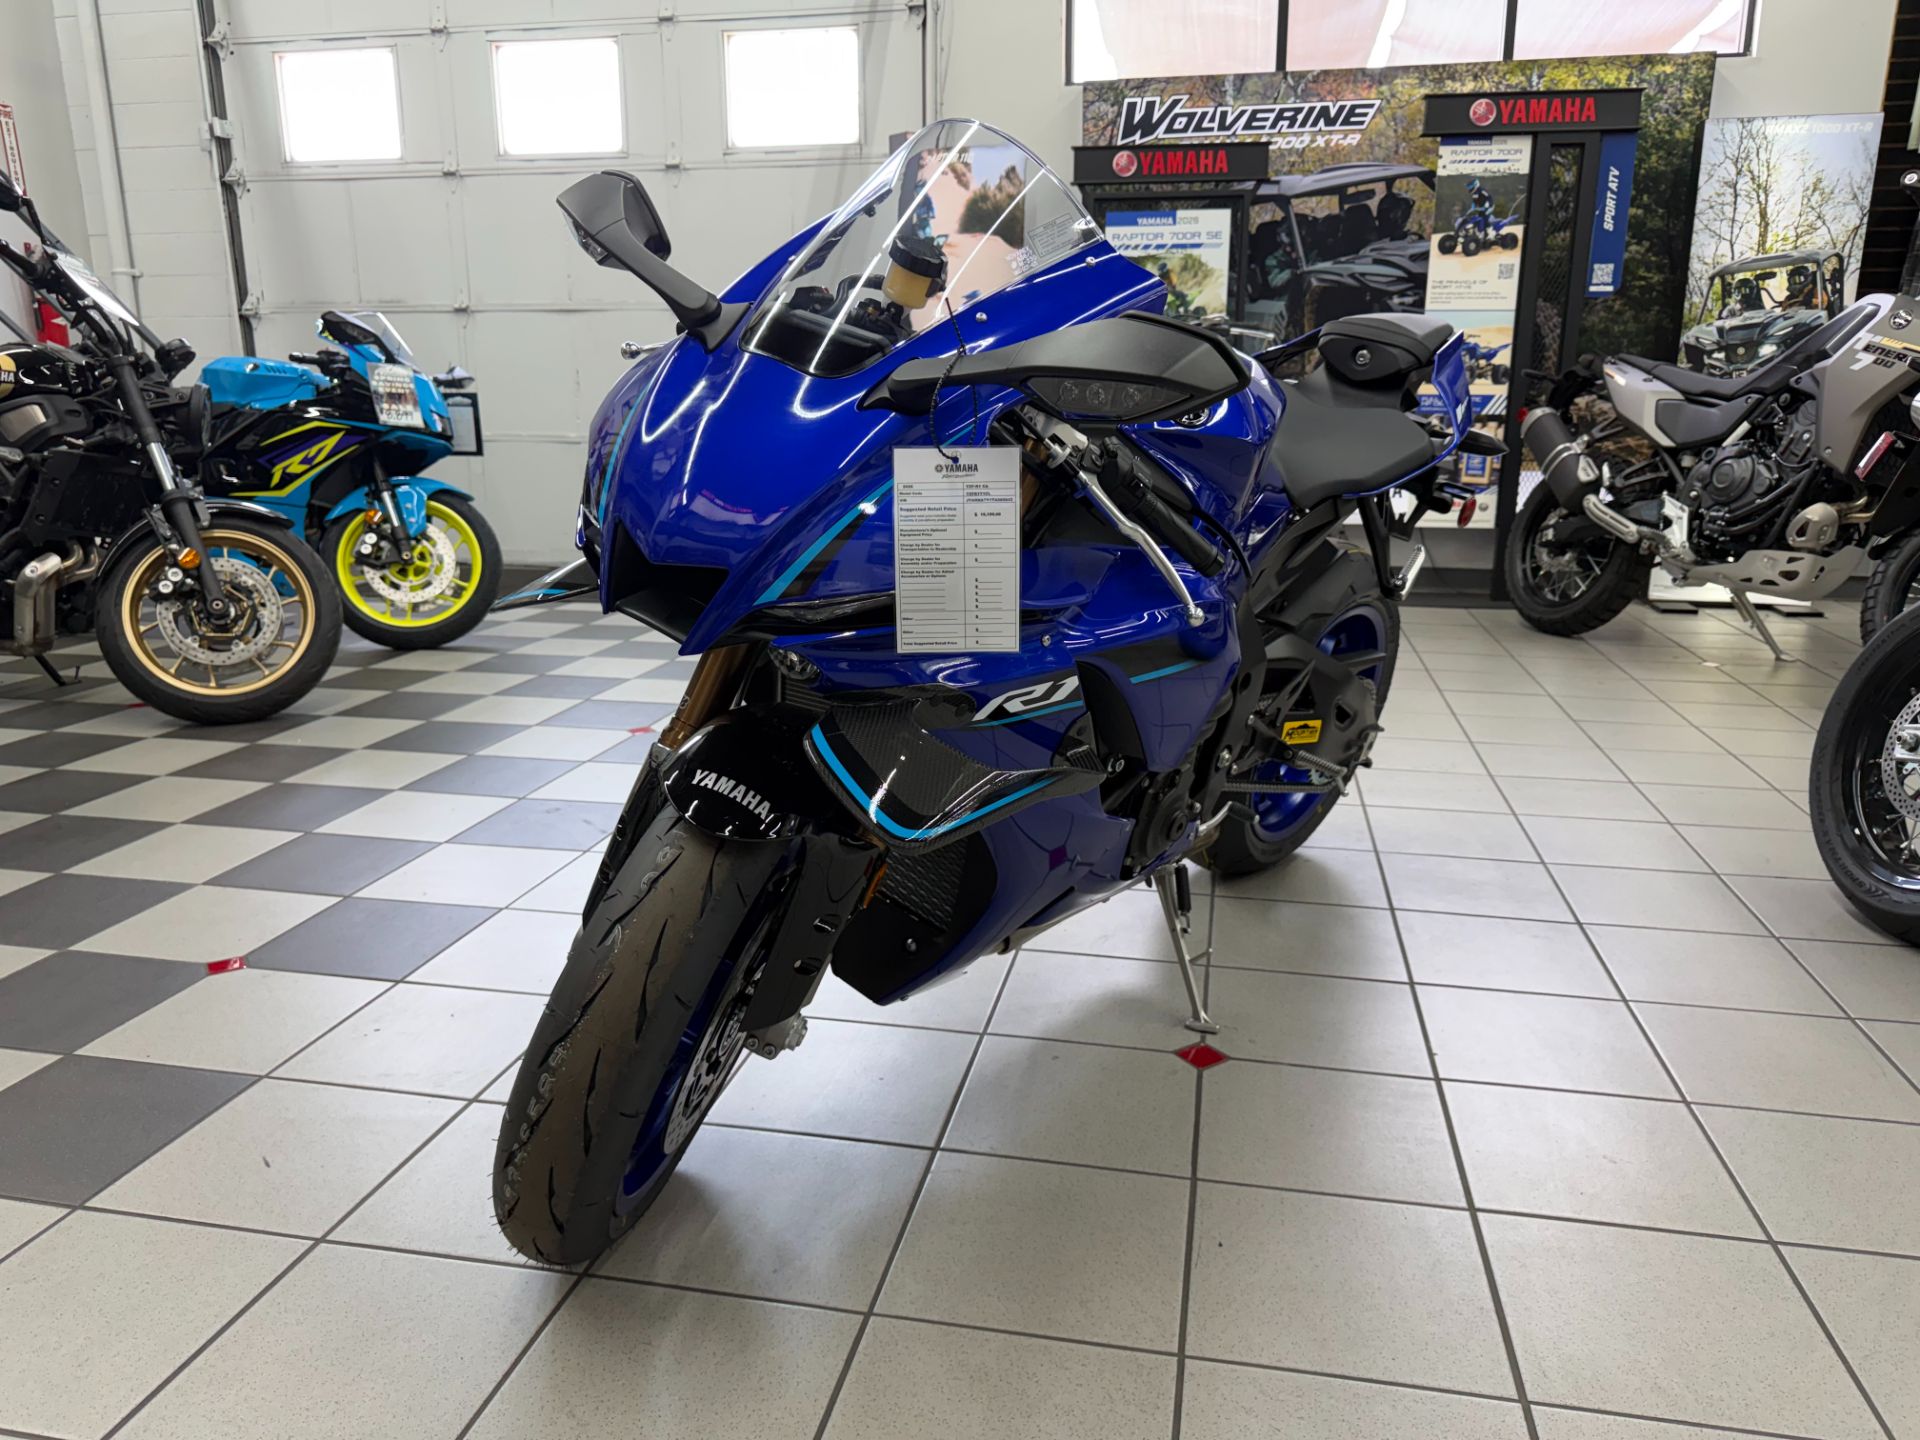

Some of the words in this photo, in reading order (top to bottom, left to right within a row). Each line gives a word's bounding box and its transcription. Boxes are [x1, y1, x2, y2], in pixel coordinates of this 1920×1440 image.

[1117, 94, 1382, 146] WOLVERINE
[1498, 96, 1597, 125] YAMAHA
[1261, 135, 1310, 150] 000
[1450, 149, 1493, 157] RAPTOR
[1495, 148, 1523, 156] 700R
[1139, 148, 1229, 175] YAMAHA
[1608, 166, 1620, 192] ATV
[1136, 216, 1174, 226] YAMAHA
[1603, 191, 1617, 232] SPORT
[1111, 231, 1165, 242] RAPTOR
[1170, 230, 1202, 241] 700R
[1205, 230, 1223, 240] SE
[944, 463, 978, 473] YAMAHA
[971, 675, 1080, 722] R1
[691, 769, 772, 820] YAMAHA
